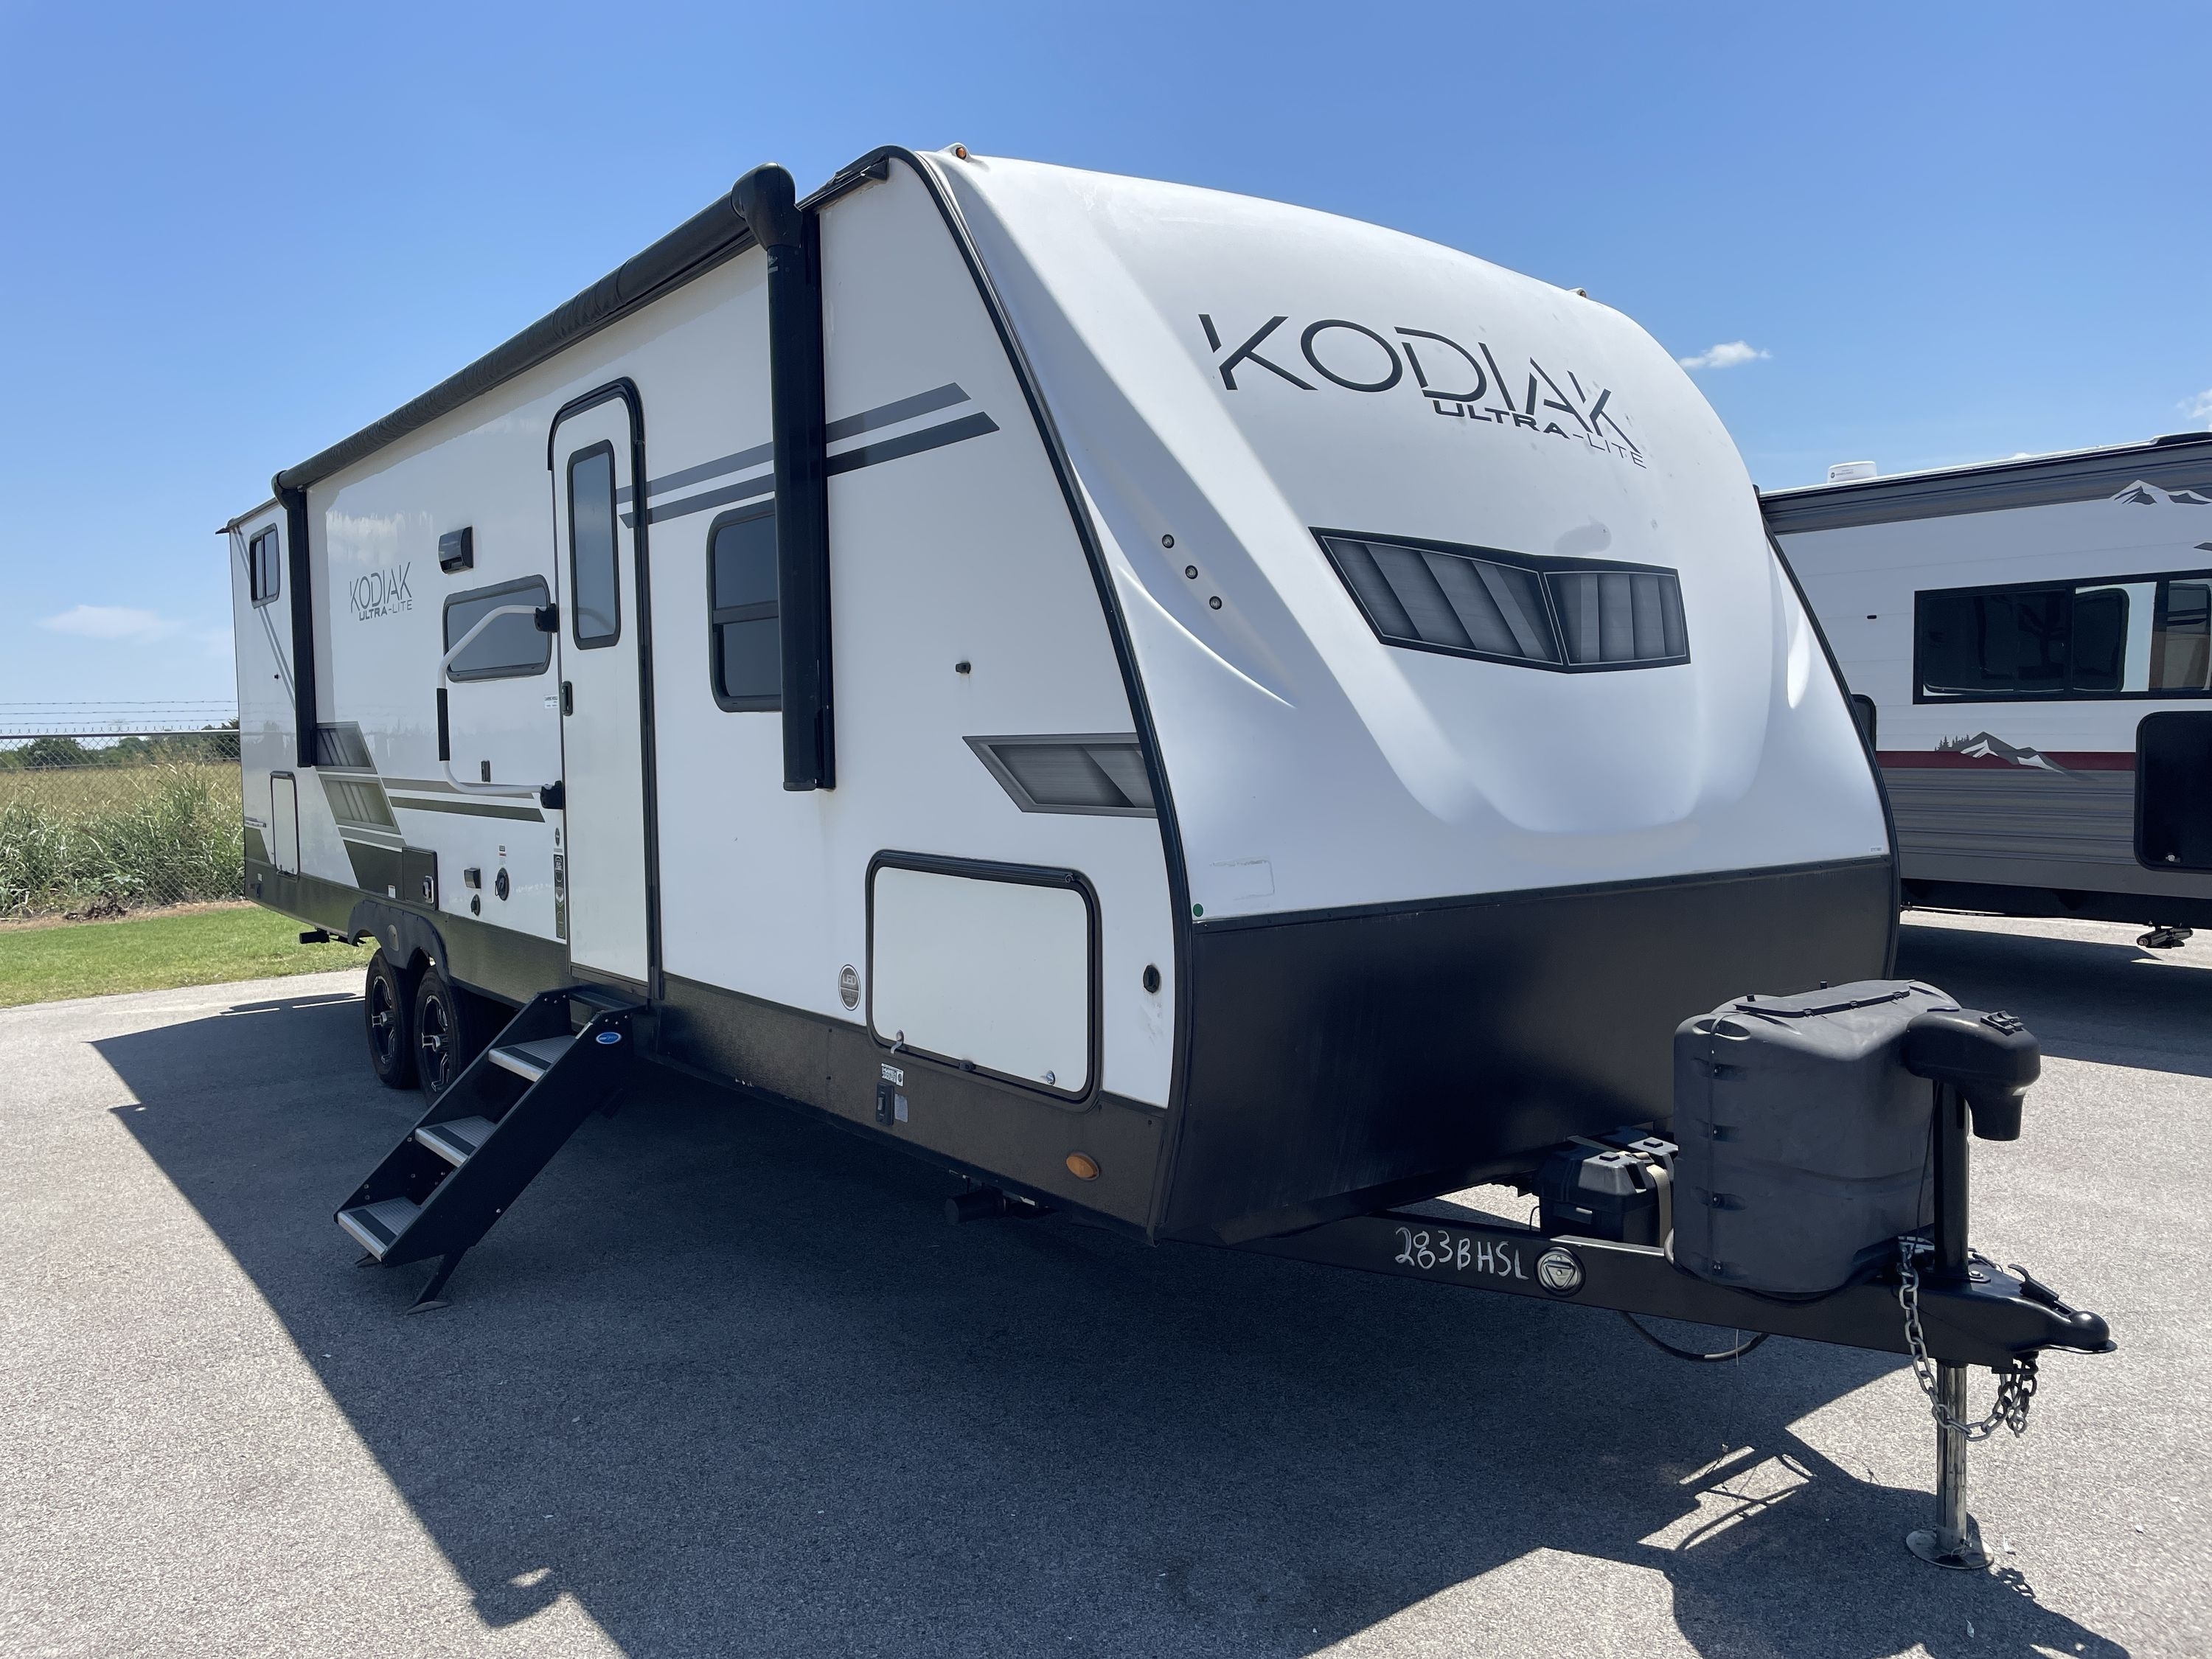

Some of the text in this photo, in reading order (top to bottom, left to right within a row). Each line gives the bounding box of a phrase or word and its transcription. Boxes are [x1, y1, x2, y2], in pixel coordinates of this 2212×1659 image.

[1197, 313, 1641, 453] KODIAK
[1432, 399, 1647, 469] ULTRA-LITE
[349, 561, 412, 613] KODIAK
[359, 599, 412, 621] ULTRA-LITE
[842, 973, 857, 985] LED
[1395, 1226, 1529, 1281] 283BHSL
